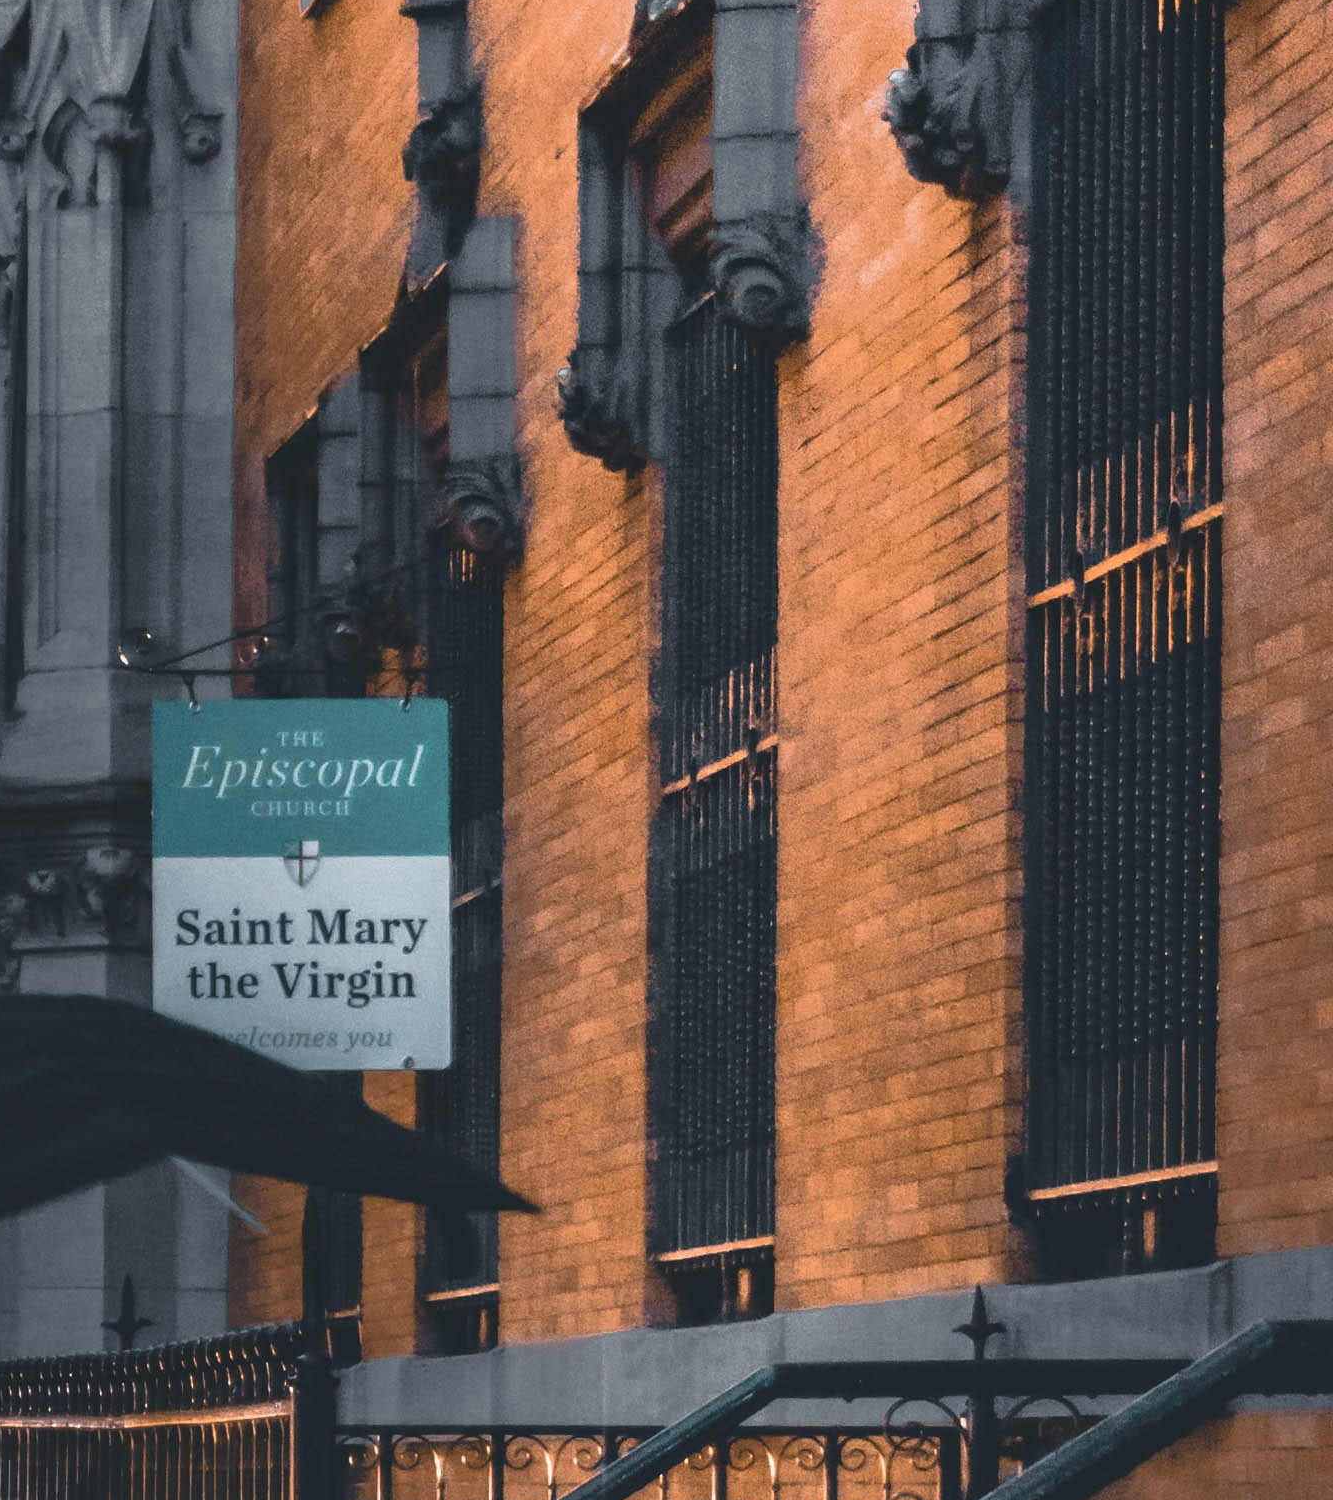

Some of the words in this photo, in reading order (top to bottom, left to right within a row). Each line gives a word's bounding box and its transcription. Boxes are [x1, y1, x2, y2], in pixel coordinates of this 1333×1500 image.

[277, 731, 324, 748] THE
[181, 743, 424, 798] Episcopal
[251, 801, 351, 818] CHURCH
[175, 908, 293, 946] Saint
[307, 908, 428, 954] Mary
[187, 961, 259, 999] the
[271, 961, 416, 1008] Virgin
[343, 1030, 394, 1053] you
